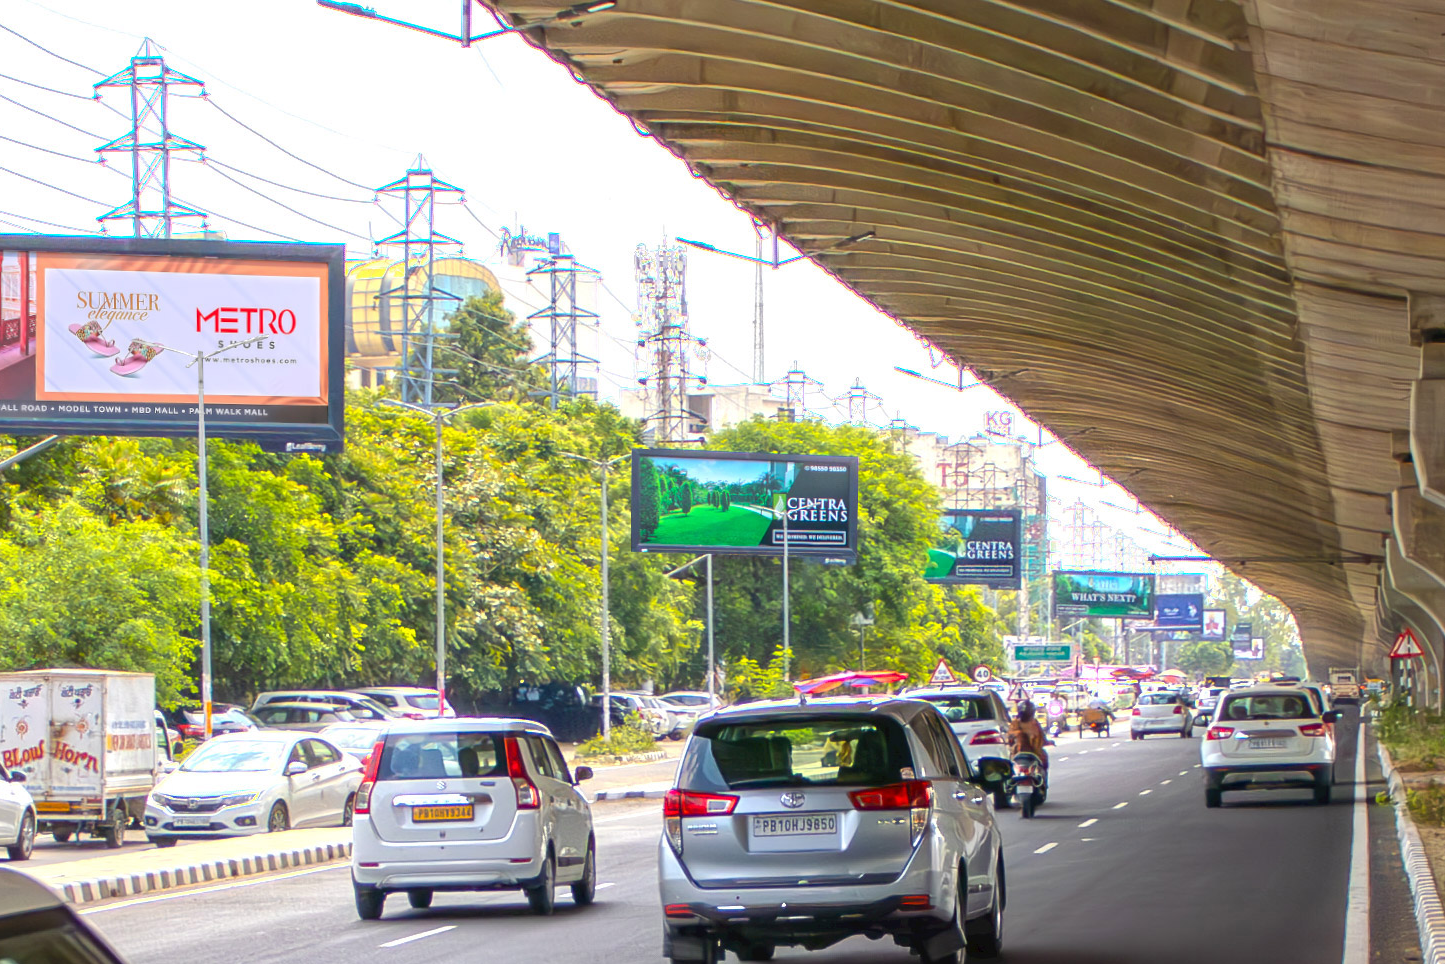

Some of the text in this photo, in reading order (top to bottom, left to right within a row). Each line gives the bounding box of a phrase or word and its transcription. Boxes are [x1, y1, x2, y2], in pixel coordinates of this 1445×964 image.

[76, 290, 160, 311] SUMMER
[87, 305, 148, 331] elegance
[196, 306, 297, 335] METRO
[218, 340, 275, 350] SHOES
[21, 404, 47, 412] ROAD
[58, 405, 90, 413] MODEL
[93, 405, 121, 413] TOWN
[131, 406, 152, 414] MBD
[155, 406, 178, 414] MALL
[189, 407, 213, 415] PAM
[244, 408, 268, 416] MALL
[787, 497, 846, 510] CENTRA
[787, 509, 848, 522] GREENS
[967, 541, 1012, 550] CENTRA
[967, 550, 1014, 559] GREENS
[1071, 592, 1137, 603] WHAT'S NEXT?
[976, 669, 989, 678] 40
[762, 818, 836, 834] PB10HJ9850
